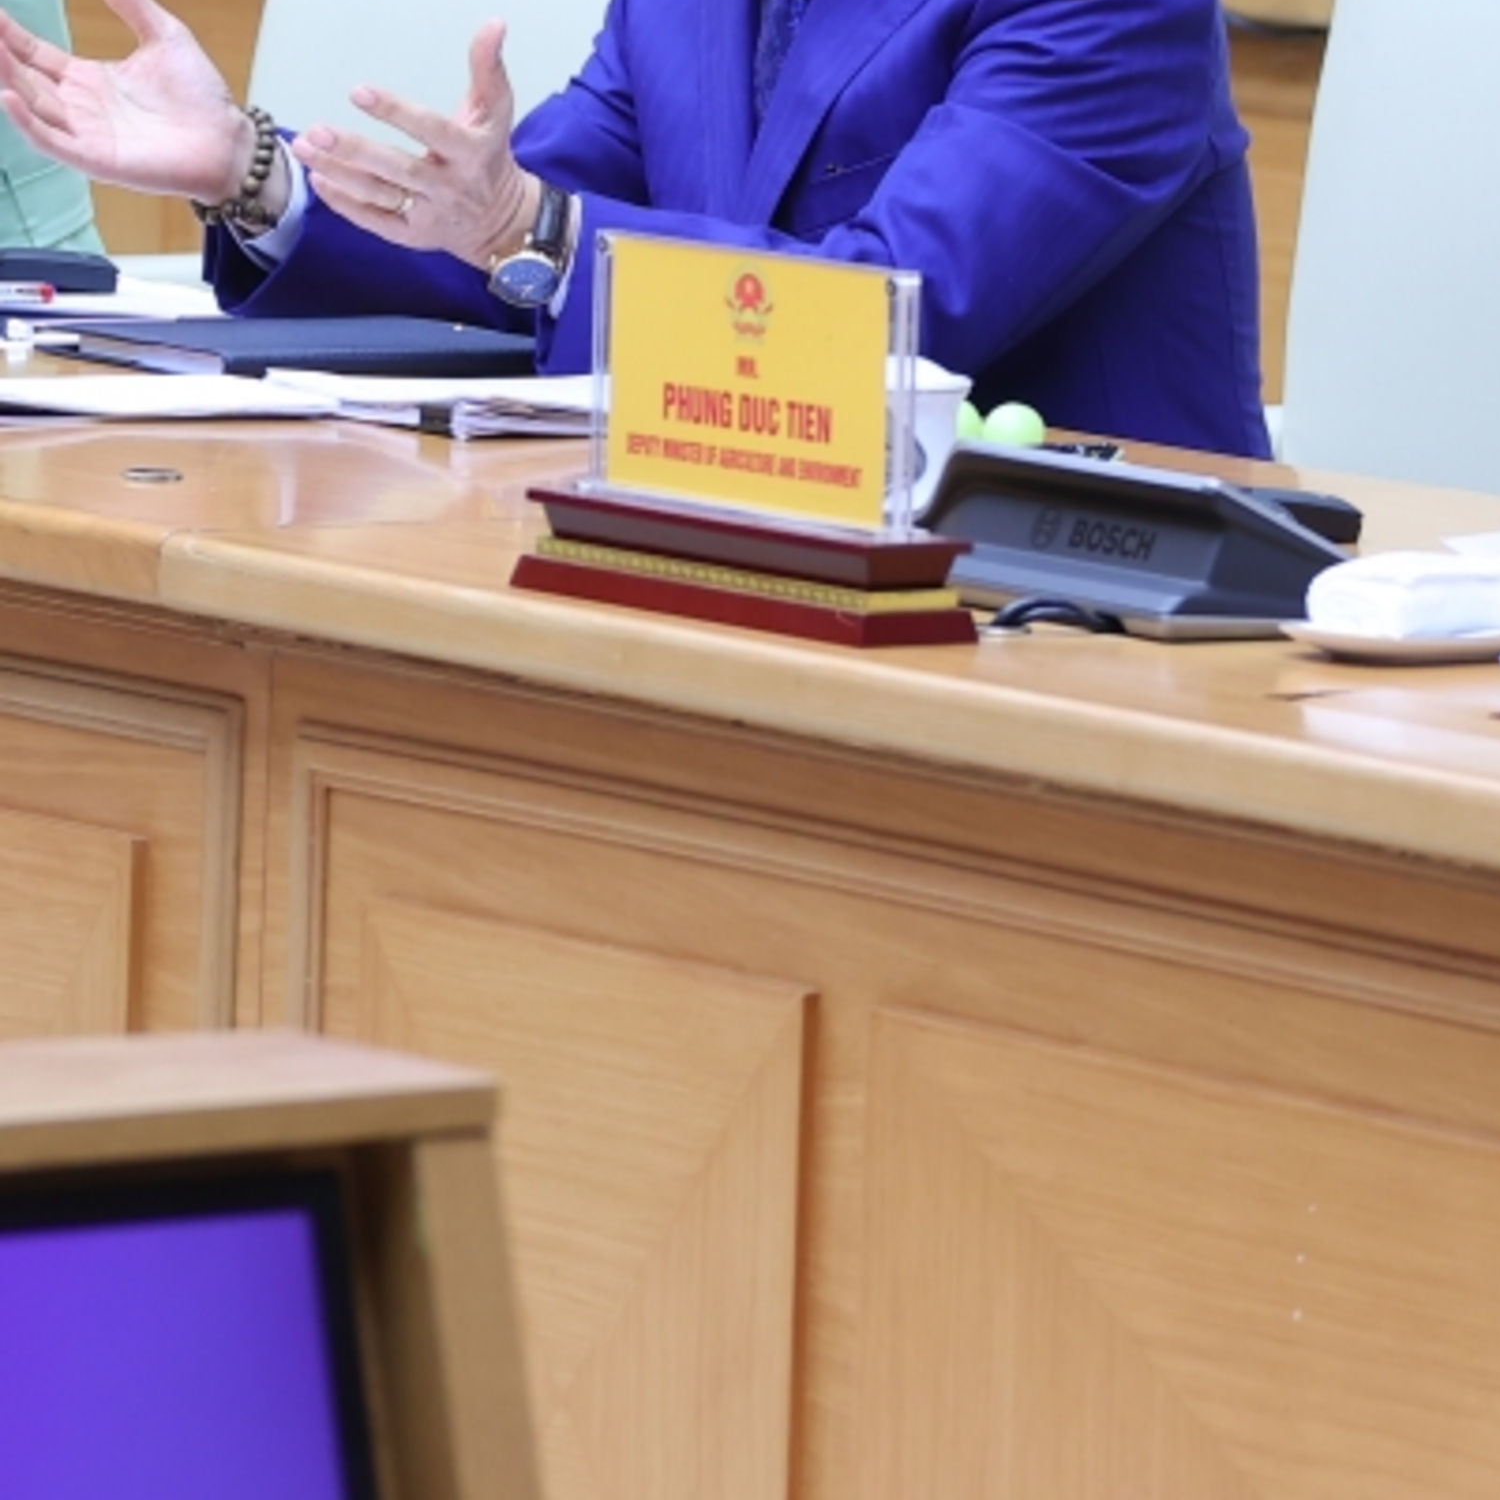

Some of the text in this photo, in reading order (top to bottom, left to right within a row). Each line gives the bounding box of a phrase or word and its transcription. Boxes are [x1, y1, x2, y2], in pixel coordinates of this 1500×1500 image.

[663, 381, 832, 444] PHUNG DUC TIEN
[1067, 517, 1156, 563] BOSCH
